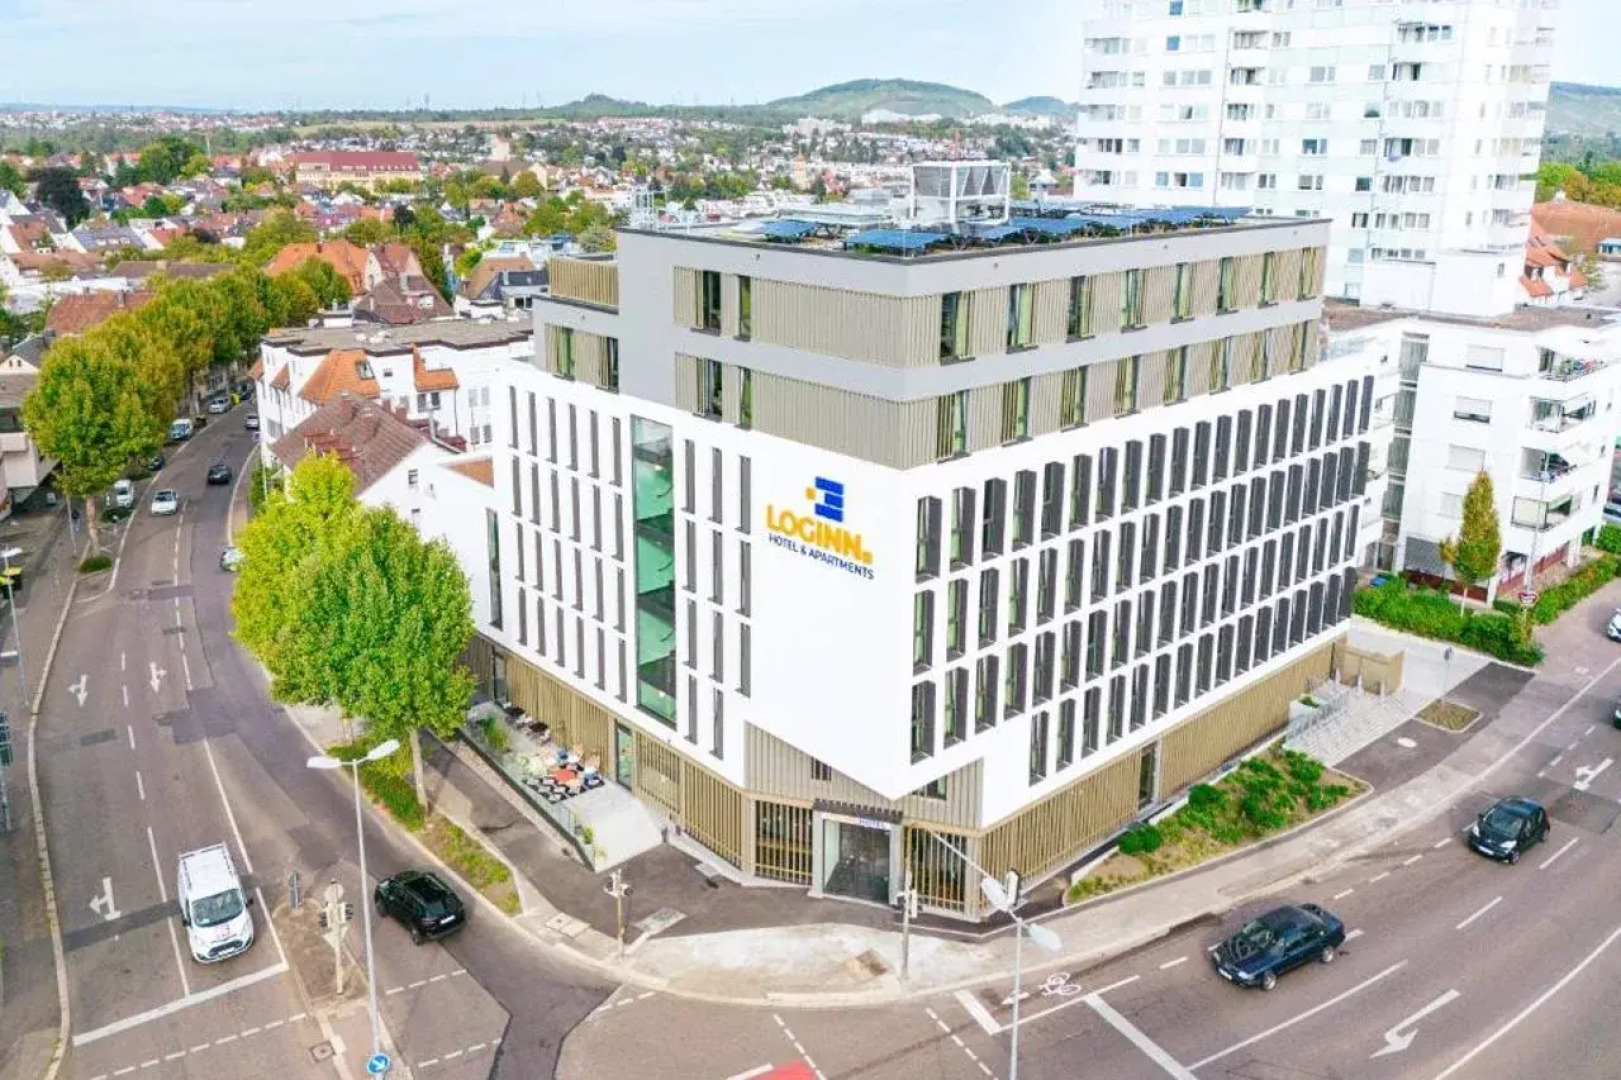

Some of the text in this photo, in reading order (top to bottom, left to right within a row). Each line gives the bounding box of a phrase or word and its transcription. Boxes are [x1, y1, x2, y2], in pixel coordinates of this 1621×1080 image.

[768, 533, 875, 580] HOTEL & APARTMENTS
